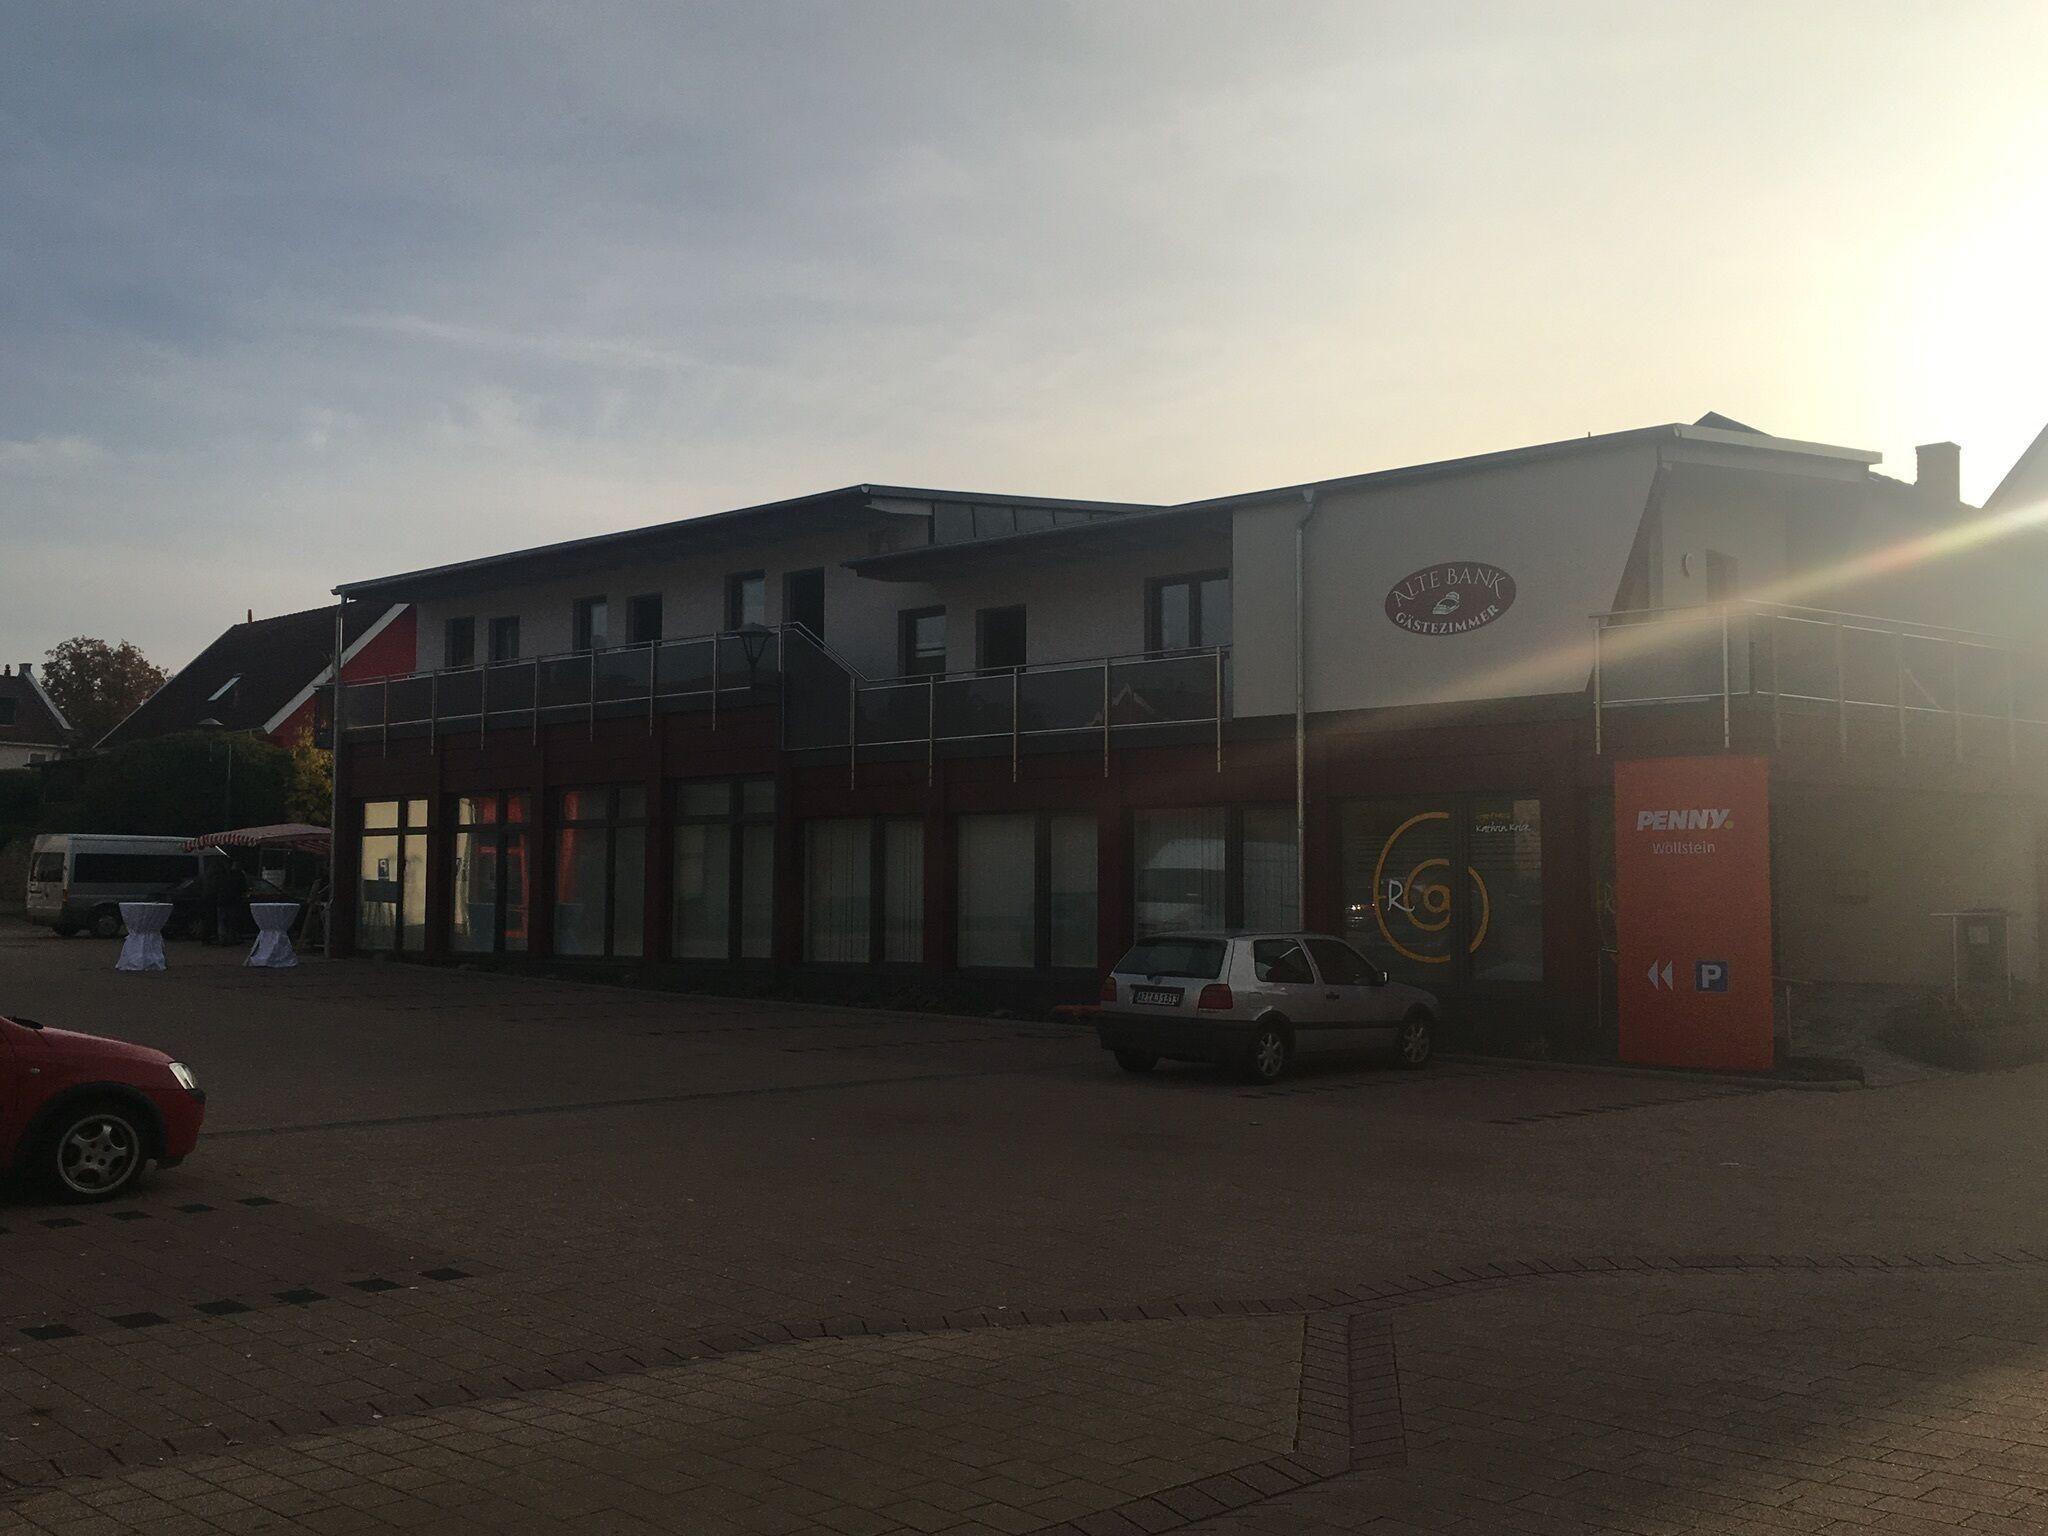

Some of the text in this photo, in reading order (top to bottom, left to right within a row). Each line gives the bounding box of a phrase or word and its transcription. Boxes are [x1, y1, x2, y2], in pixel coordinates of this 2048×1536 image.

[1392, 568, 1506, 607] ALTE BANK
[1395, 603, 1500, 634] GÄSTEZIMMER
[1701, 964, 1722, 988] P
